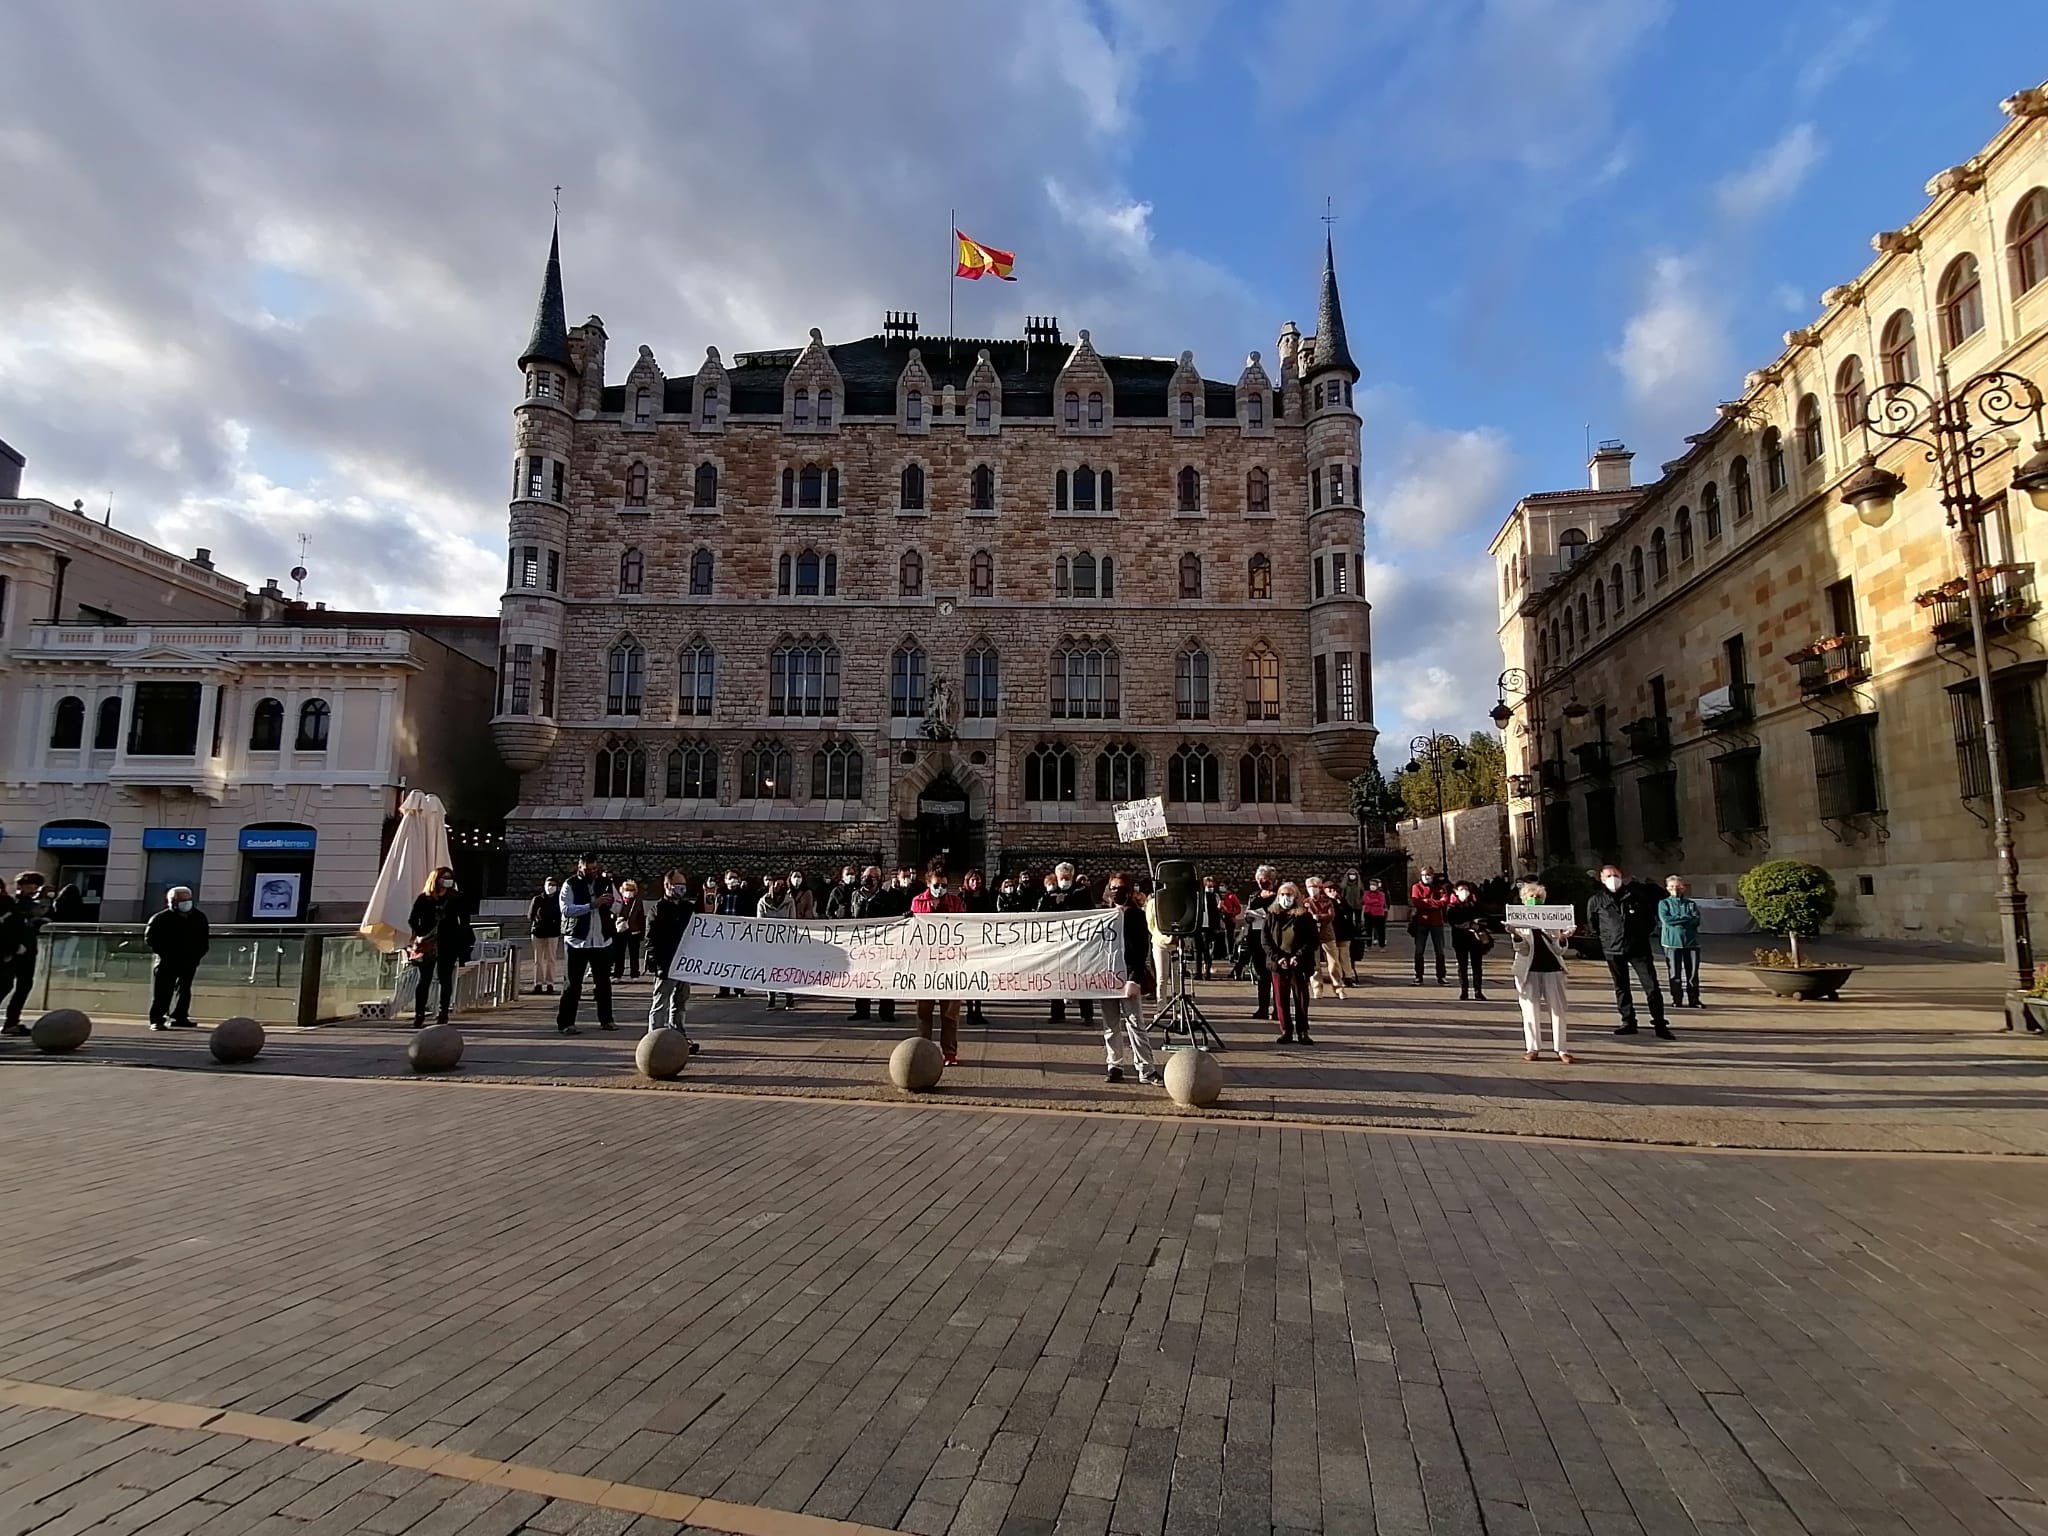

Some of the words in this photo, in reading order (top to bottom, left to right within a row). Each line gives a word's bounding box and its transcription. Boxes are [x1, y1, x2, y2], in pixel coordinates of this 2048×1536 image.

[1133, 820, 1147, 829] NO
[1542, 912, 1572, 921] DIGNIDAD
[692, 917, 811, 944] PLATAFORMA
[824, 925, 844, 945] DE
[850, 922, 964, 945] AFECTADOS
[982, 920, 1118, 946] RESIDENCIAS
[849, 946, 908, 960] CASTILLA
[914, 946, 921, 960] Y
[676, 957, 702, 973] POR
[893, 971, 916, 990] POR
[991, 972, 1052, 990] DERECHOS
[1059, 970, 1127, 990] HUMANOS
